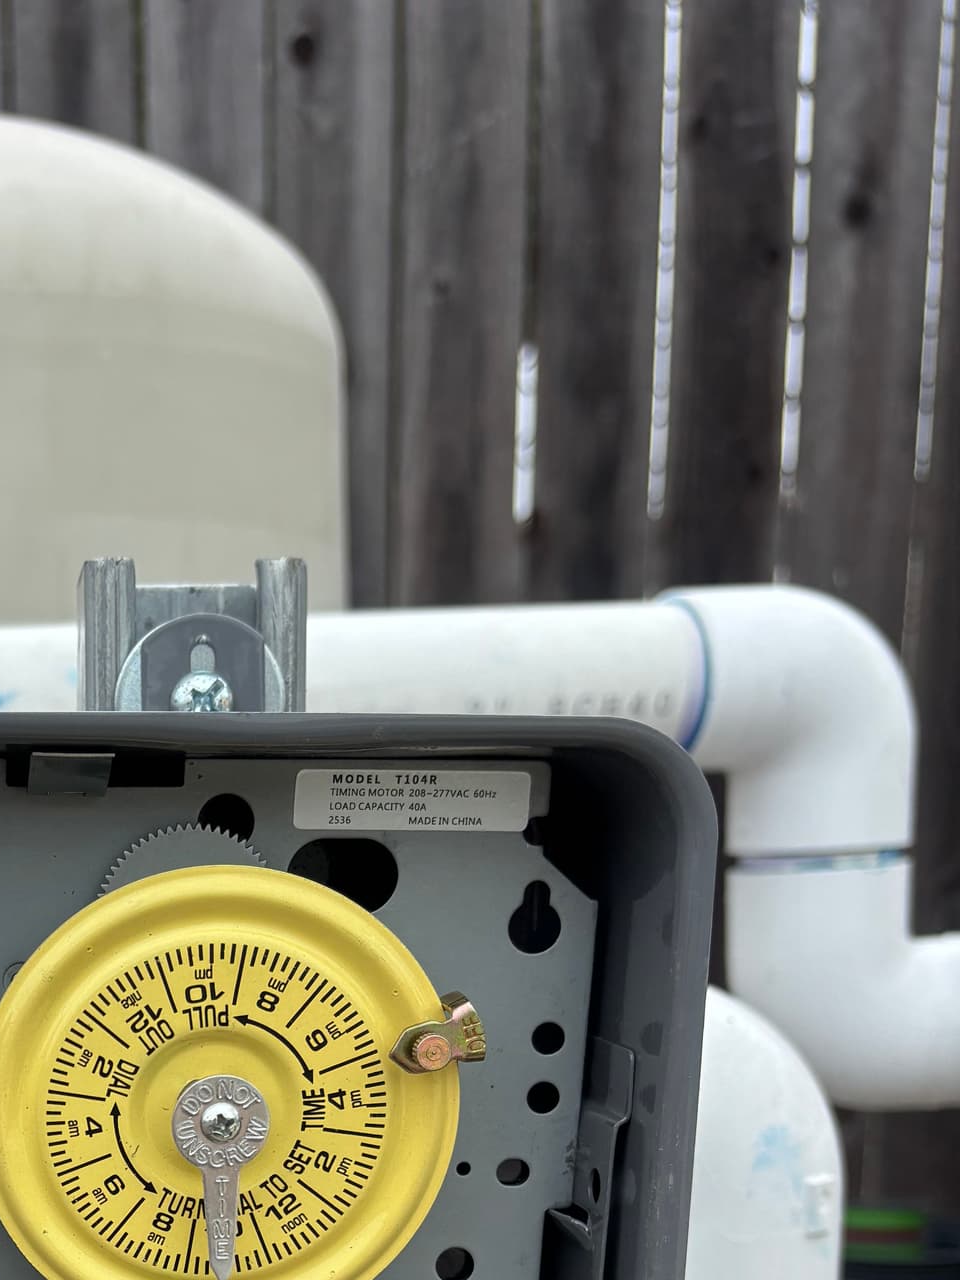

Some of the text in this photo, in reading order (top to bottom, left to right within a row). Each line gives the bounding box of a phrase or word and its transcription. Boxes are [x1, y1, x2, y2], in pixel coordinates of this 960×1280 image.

[332, 775, 437, 785] MODEL T104R
[331, 788, 496, 798] TIMING MOTOR 208-277VAC 60Hz
[330, 802, 426, 811] LOAD CAPACITY 40A
[329, 816, 351, 824] 2536
[409, 816, 482, 826] MADE IN CHINA
[195, 965, 213, 980] pm
[185, 982, 225, 1004] 10
[268, 977, 290, 993] pm
[121, 990, 142, 1009] nite
[256, 991, 280, 1012] 8
[126, 1004, 162, 1033] 12
[305, 1029, 328, 1052] 6
[325, 1021, 347, 1040] pm
[77, 1050, 93, 1068] am
[106, 1004, 229, 1098] PULL OUT DIAL
[92, 1056, 113, 1078] 2
[181, 1080, 261, 1115] DO NOT
[328, 1089, 346, 1110] 4
[351, 1090, 367, 1108] pm
[68, 1119, 80, 1138] am
[85, 1117, 103, 1138] 4
[176, 1117, 267, 1168] UNSCREW
[259, 1174, 289, 1199] TO
[283, 1140, 316, 1175] SET
[301, 1088, 326, 1132] TIME
[314, 1151, 337, 1173] 2
[336, 1157, 352, 1177] pm
[103, 1174, 125, 1195] 6
[92, 1187, 108, 1205] am
[265, 1193, 302, 1220] 12
[152, 1212, 174, 1232] 8
[214, 1175, 231, 1260] TIME
[281, 1213, 308, 1234] noon
[147, 1232, 166, 1246] am
